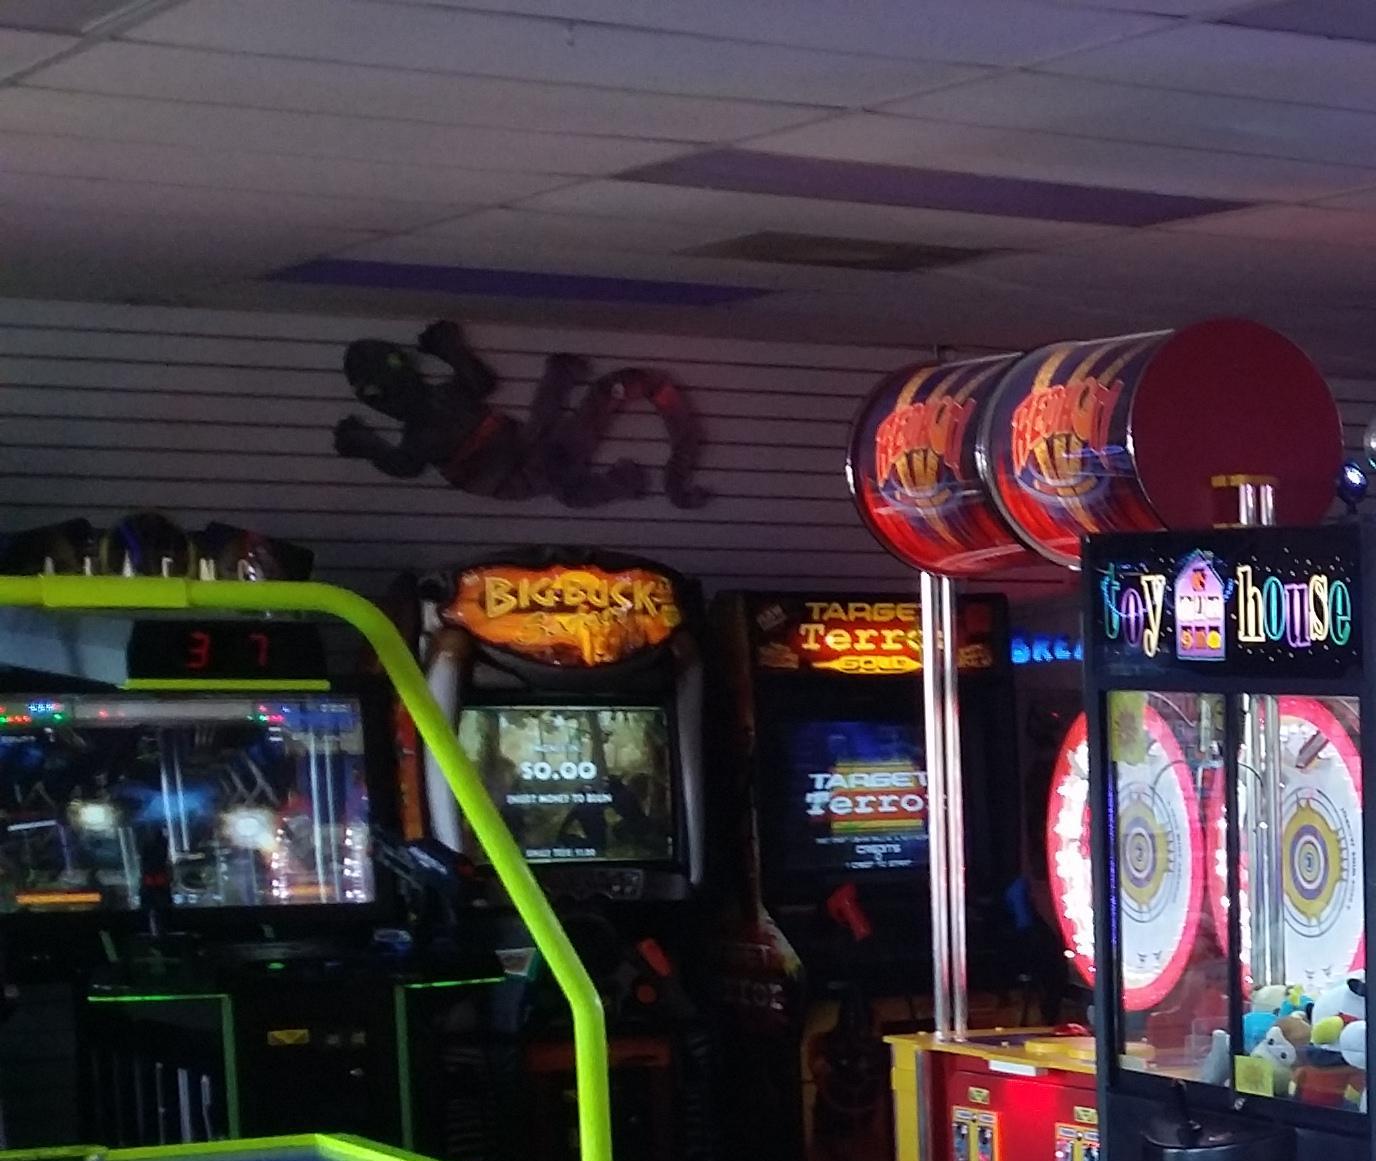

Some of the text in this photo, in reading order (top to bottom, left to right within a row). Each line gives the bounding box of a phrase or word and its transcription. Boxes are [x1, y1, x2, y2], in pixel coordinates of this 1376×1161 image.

[1101, 561, 1352, 658] toy house
[519, 761, 598, 780] $0.00
